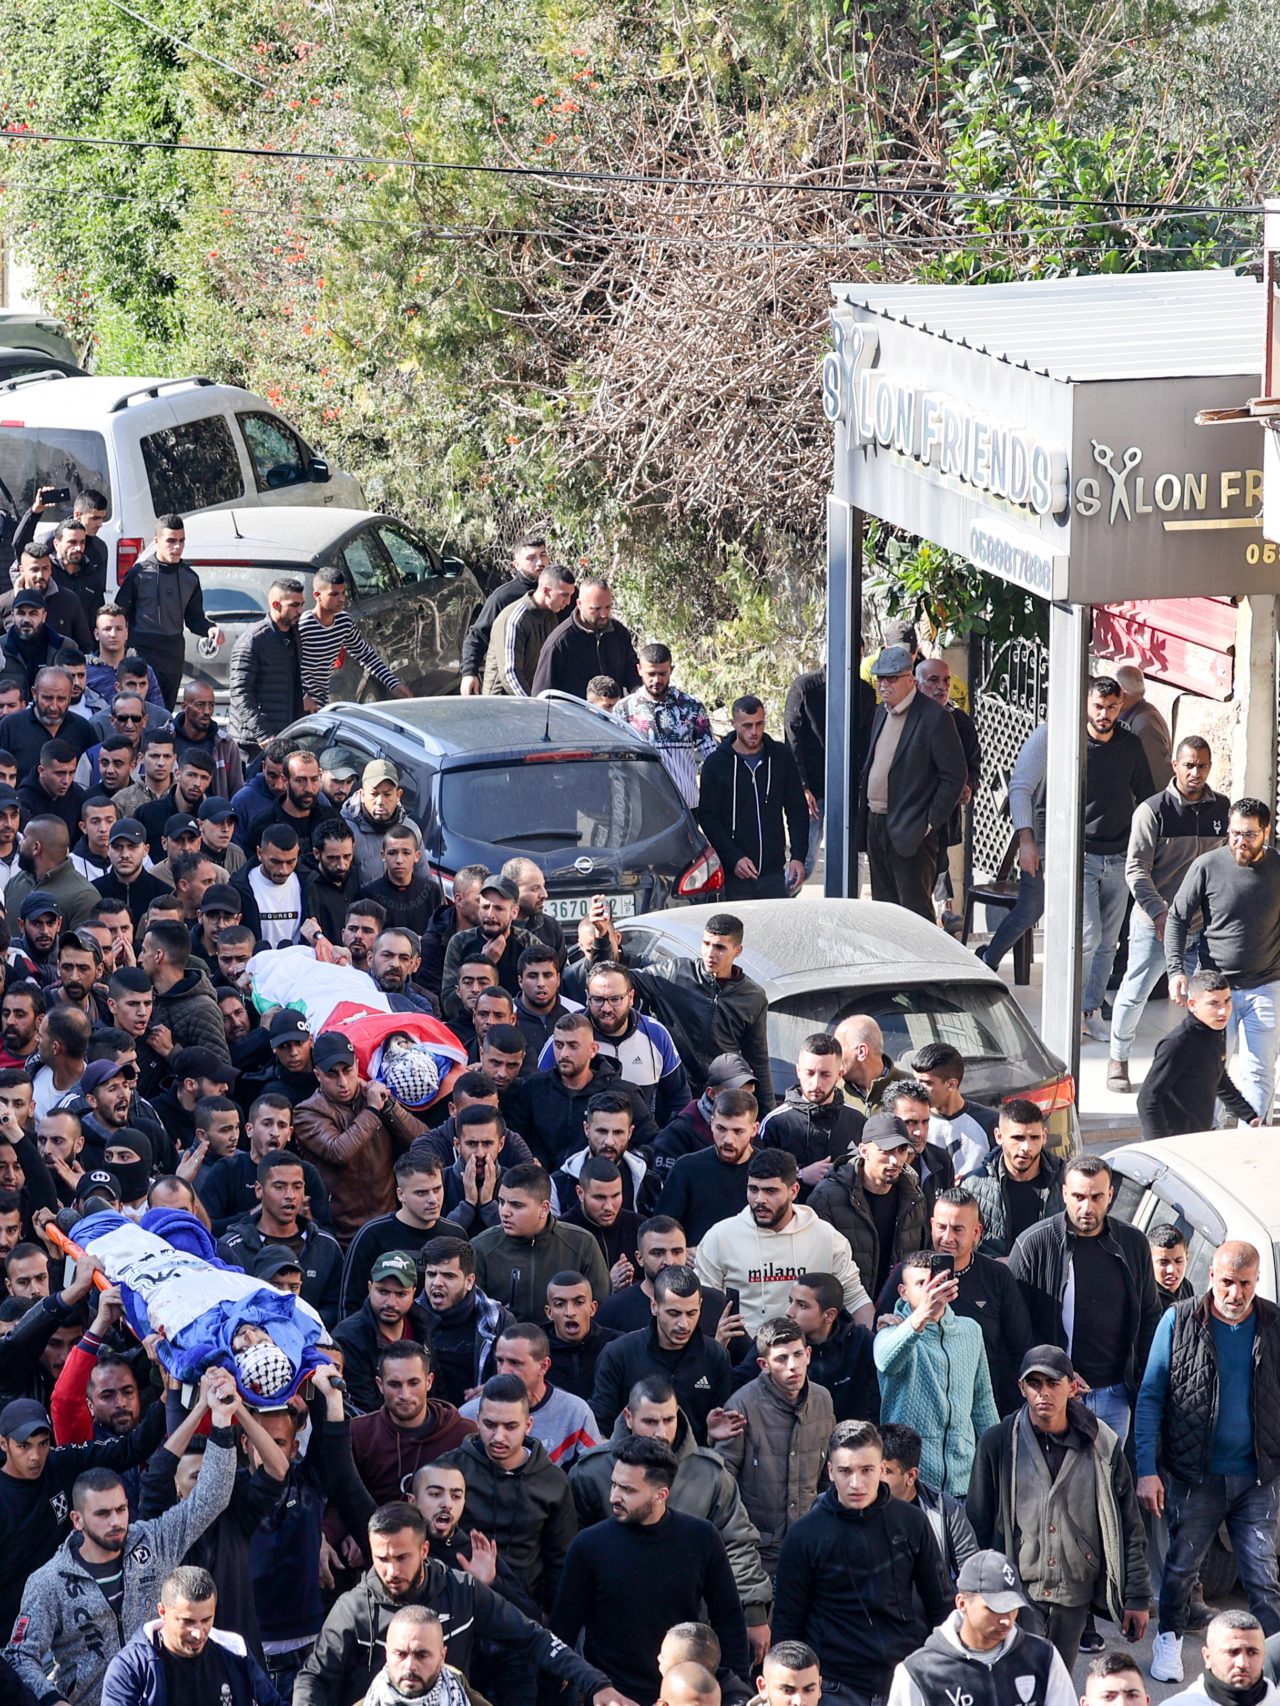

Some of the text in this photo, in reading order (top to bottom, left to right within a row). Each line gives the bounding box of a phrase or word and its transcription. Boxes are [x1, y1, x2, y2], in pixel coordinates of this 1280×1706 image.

[920, 393, 1052, 515] FRIENDS
[381, 1260, 403, 1269] PUMA
[748, 1261, 806, 1278] milano
